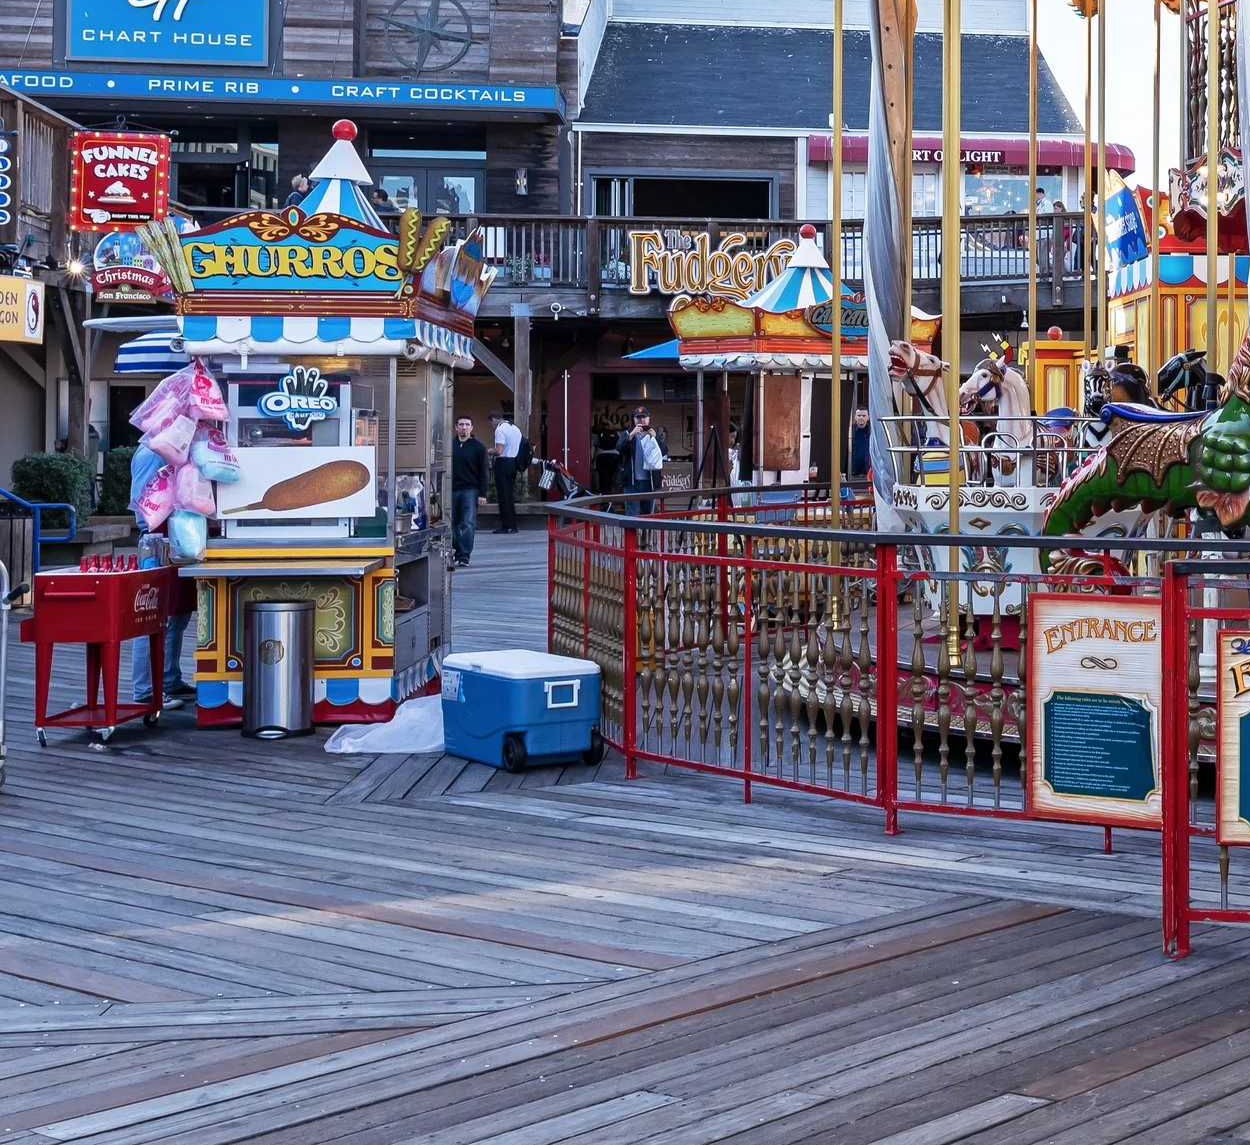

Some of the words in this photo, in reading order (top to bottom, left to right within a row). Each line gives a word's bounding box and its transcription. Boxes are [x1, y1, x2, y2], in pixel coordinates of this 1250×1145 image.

[82, 29, 162, 43] CHART
[174, 32, 252, 46] HOUSE
[149, 79, 214, 93] PRIME
[225, 81, 259, 93] RIB
[332, 86, 400, 99] CRAFT
[410, 88, 525, 102] COCKTAILS
[81, 145, 159, 166] FUNNEL
[960, 151, 1001, 162] LIGHT
[94, 163, 149, 181] CAKES
[664, 230, 691, 249] The
[183, 242, 402, 282] CHURROS
[96, 270, 155, 285] Christmas
[99, 292, 113, 300] San
[115, 292, 150, 300] Francisco
[267, 396, 334, 411] OREO
[1043, 618, 1157, 654] ENTRANCE
